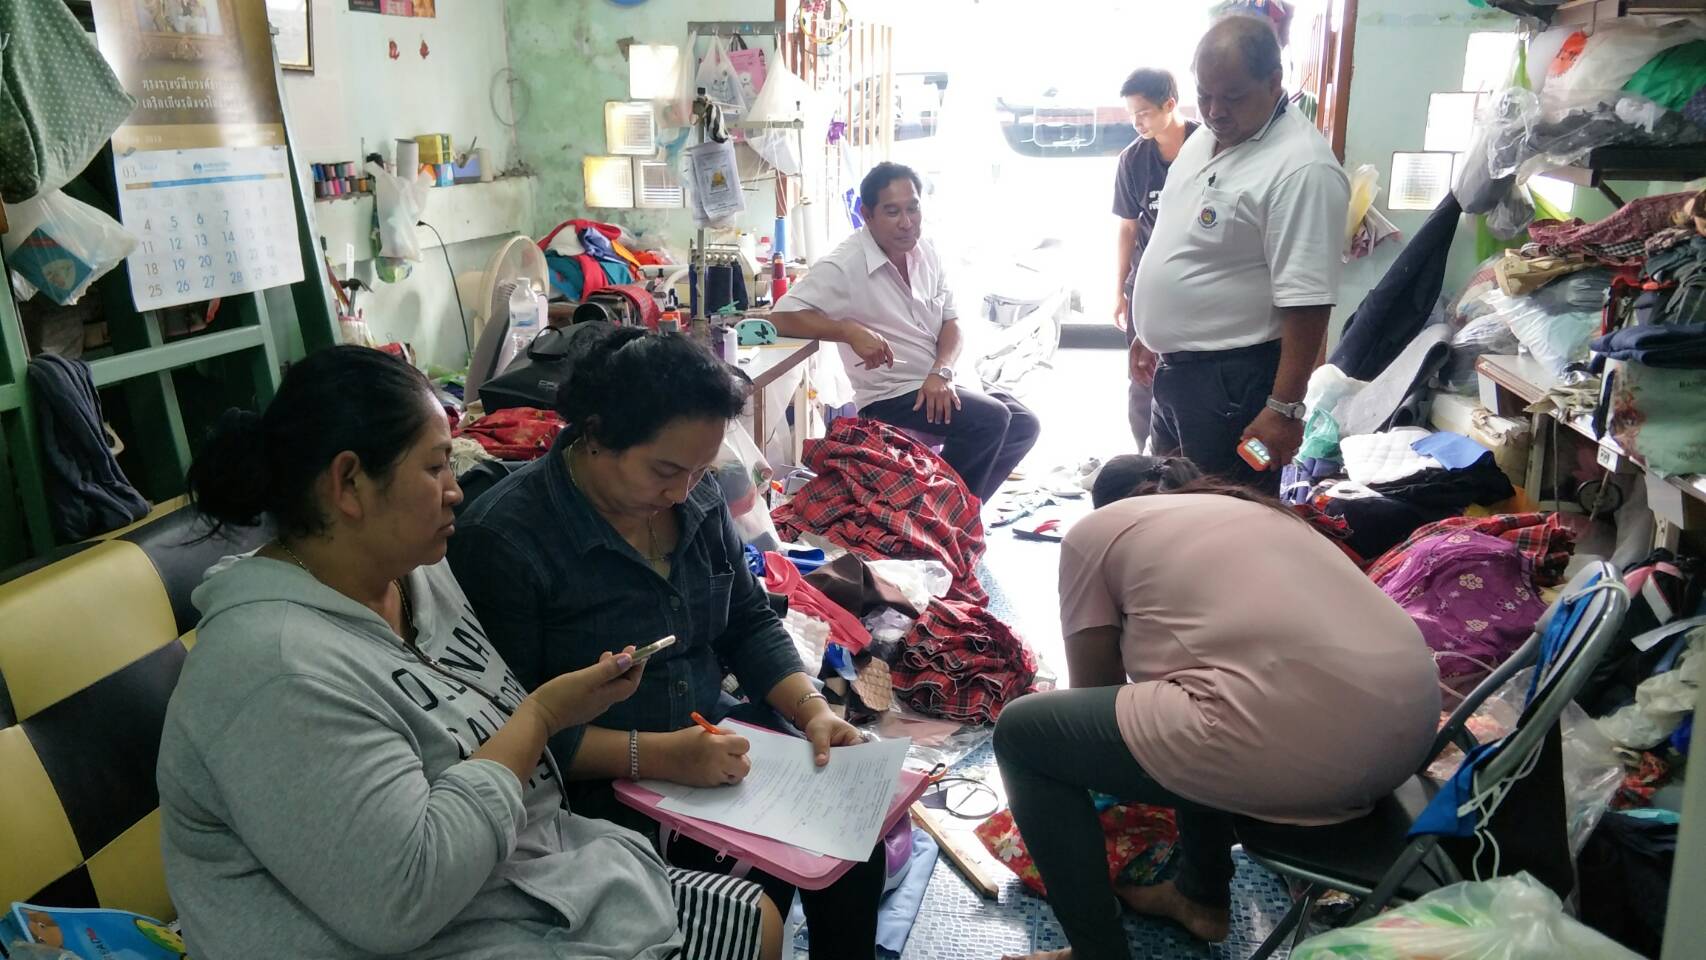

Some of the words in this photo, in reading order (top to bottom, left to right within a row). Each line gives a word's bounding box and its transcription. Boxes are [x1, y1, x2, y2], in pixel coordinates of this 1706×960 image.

[122, 167, 137, 178] 03
[144, 219, 152, 230] 4
[170, 216, 178, 228] 5
[196, 213, 204, 225] 6
[223, 210, 230, 222] 7
[142, 241, 154, 254] 11
[169, 238, 182, 250] 12
[195, 234, 208, 247] 13
[222, 231, 235, 243] 14
[145, 263, 159, 275] 18
[173, 258, 185, 271] 19
[198, 255, 211, 268] 20
[226, 251, 238, 264] 21
[149, 285, 163, 298] 25
[177, 279, 190, 293] 26
[203, 276, 215, 288] 27
[230, 272, 243, 284] 28
